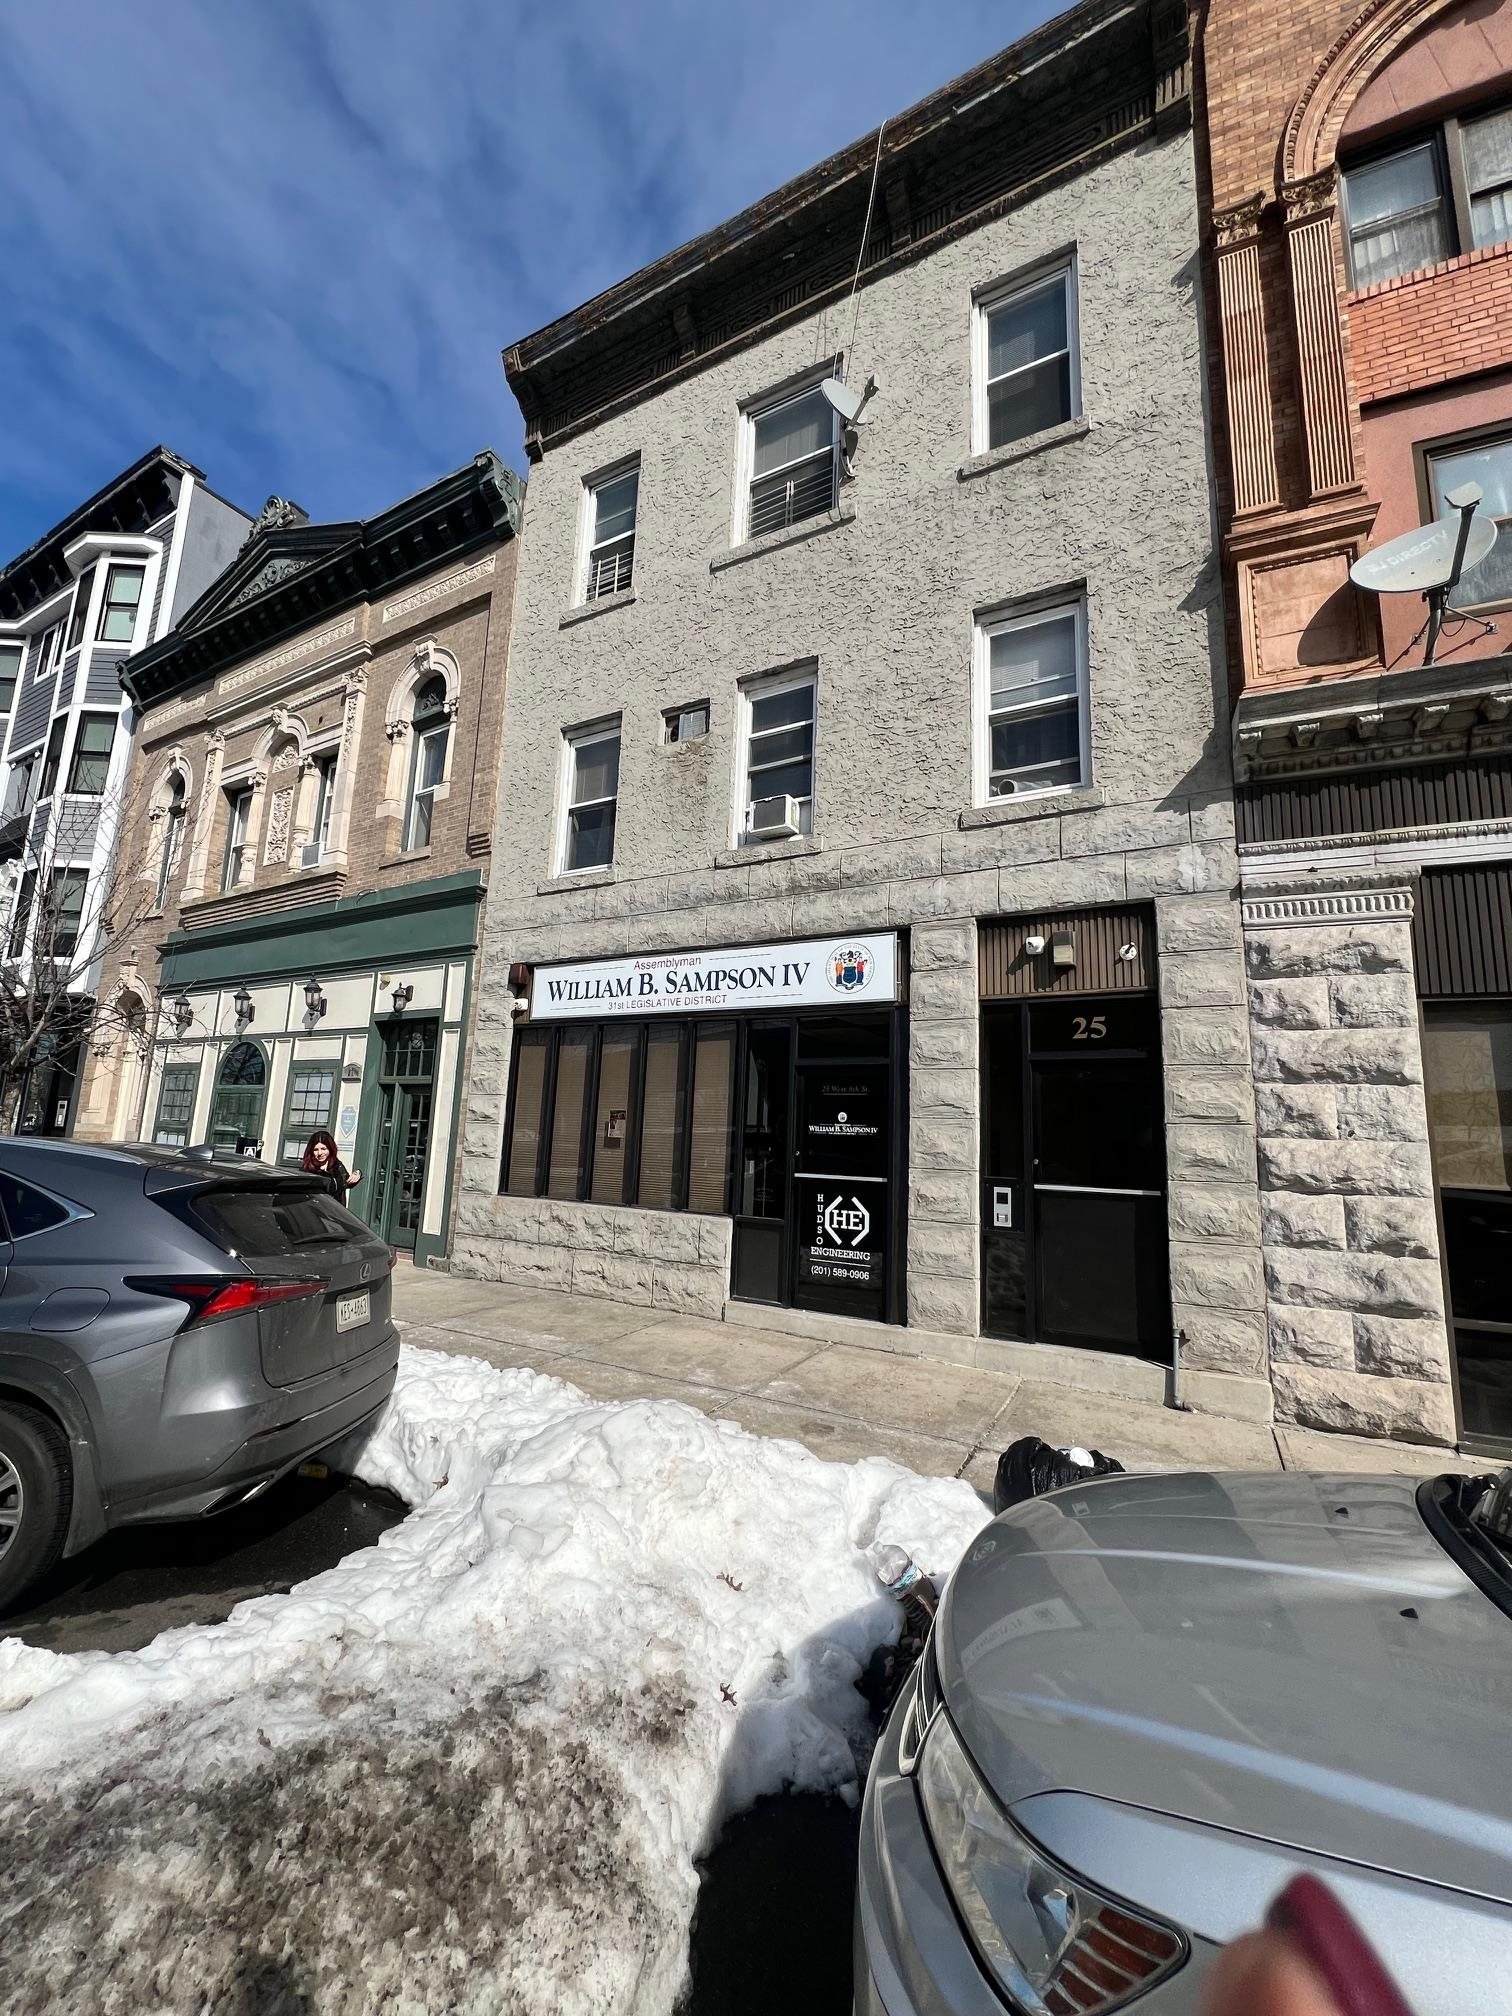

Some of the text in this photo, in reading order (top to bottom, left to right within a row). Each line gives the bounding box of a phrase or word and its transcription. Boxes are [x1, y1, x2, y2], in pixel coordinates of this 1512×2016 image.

[1390, 529, 1448, 566] DIRECTV
[633, 956, 702, 971] Assemblyman
[547, 977, 633, 1002] WILLIAM
[638, 972, 659, 996] B.
[665, 966, 776, 994] SAMPSON
[782, 962, 811, 986] IV
[608, 994, 728, 1010] 31st LEGISLATIVE DISTRICT
[1072, 1015, 1107, 1039] 25
[808, 1124, 835, 1132] WILLIAM
[831, 1209, 863, 1231] HE
[810, 1246, 871, 1261] ENGINEERING
[811, 1265, 870, 1281] (201) 589-0906
